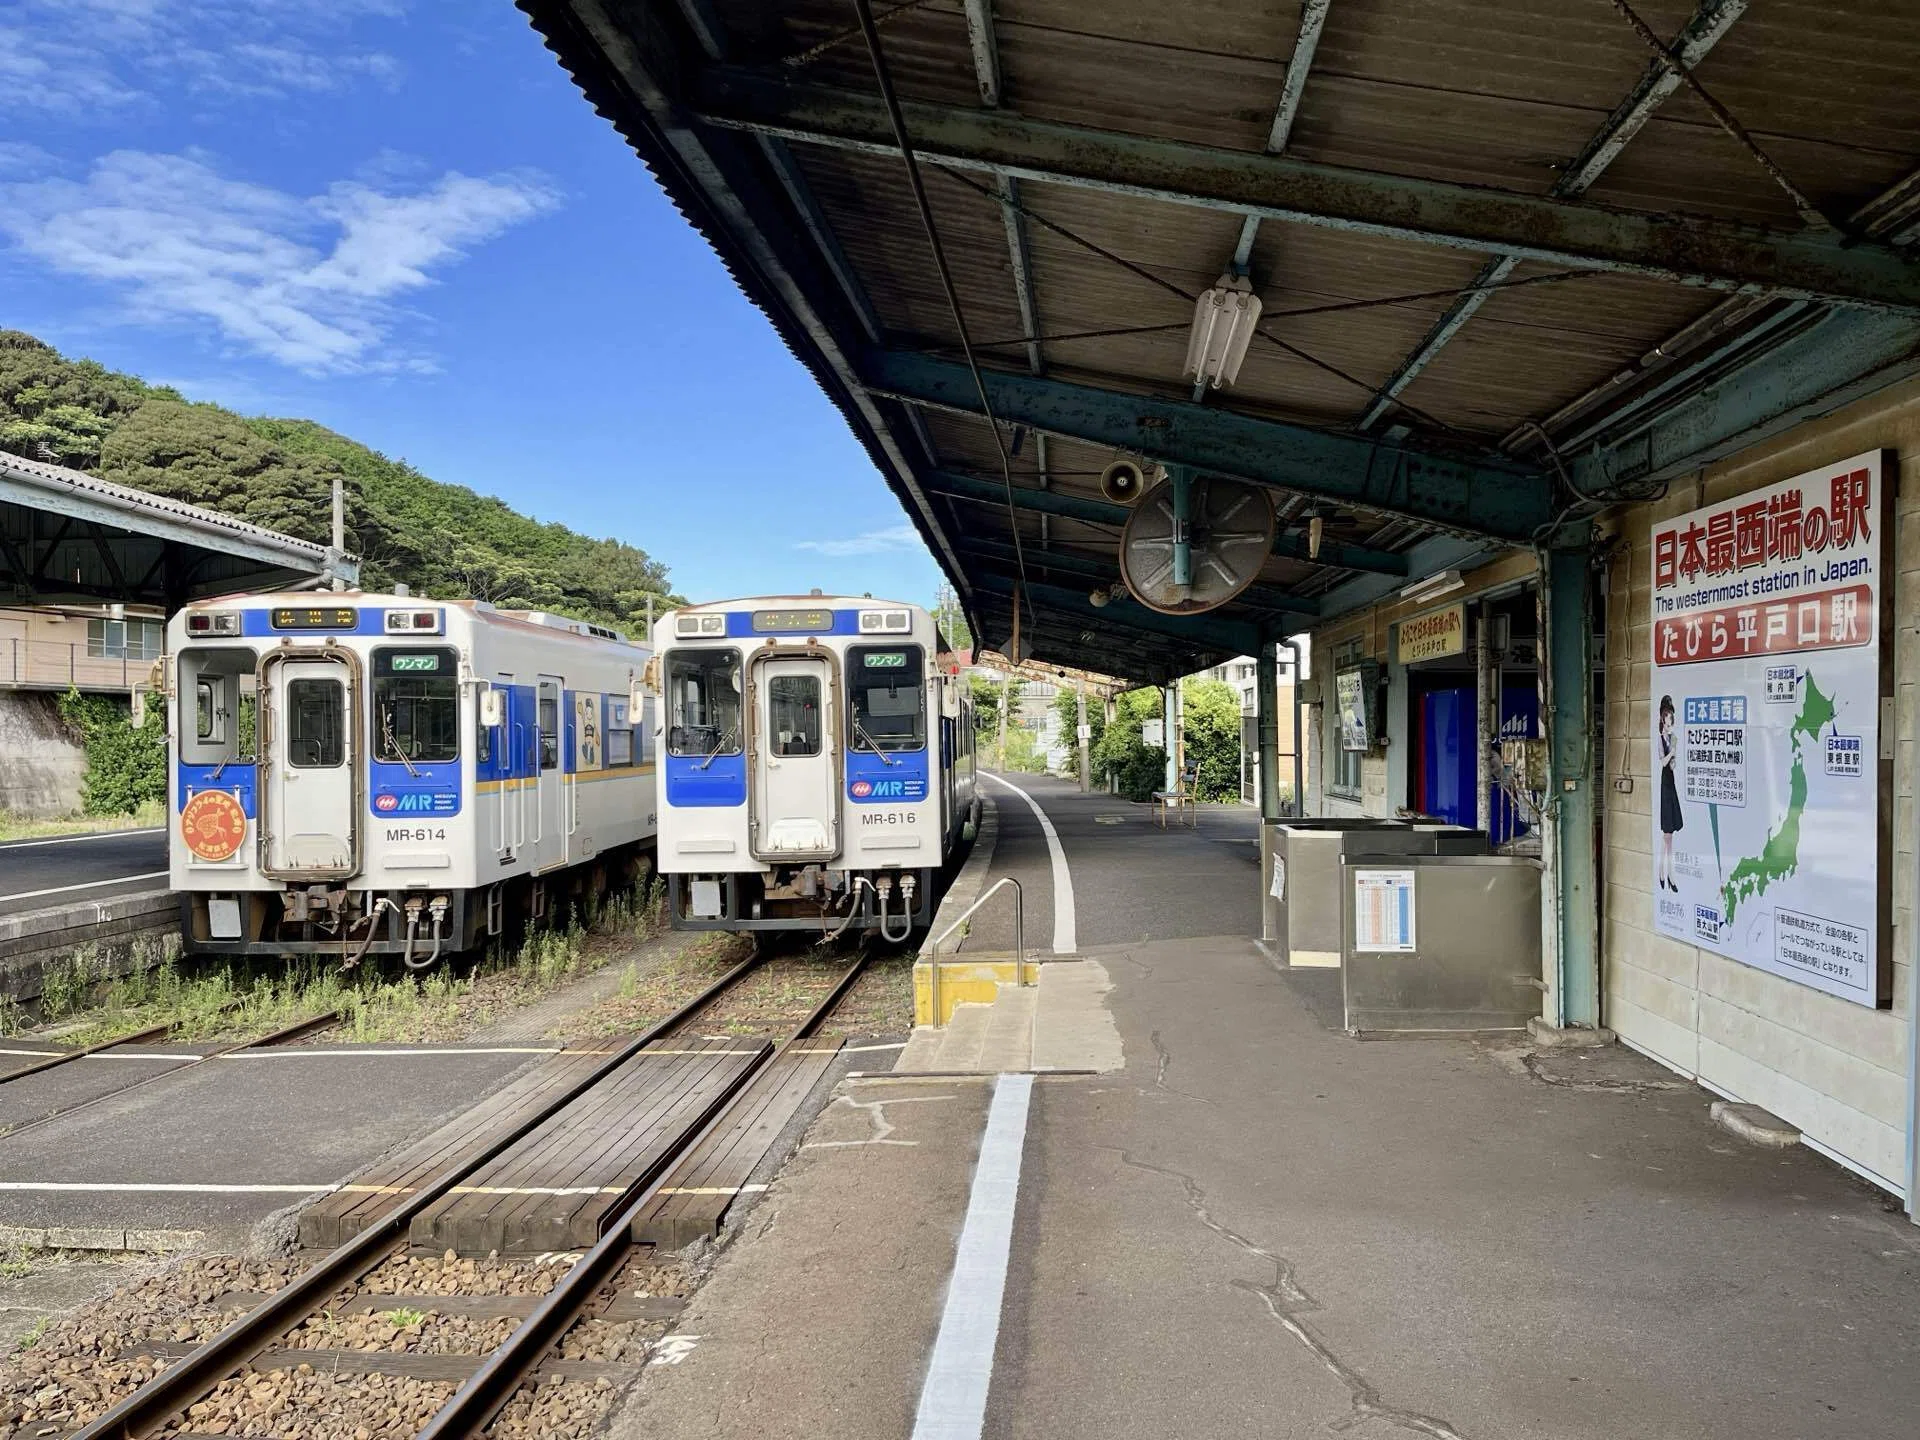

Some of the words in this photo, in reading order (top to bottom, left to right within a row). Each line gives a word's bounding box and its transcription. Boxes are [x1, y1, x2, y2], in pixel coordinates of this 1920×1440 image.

[1655, 468, 1871, 591] 日本最西端の駅
[1655, 596, 1674, 614] The
[1676, 580, 1750, 609] westernmost
[1752, 568, 1799, 595] station
[1803, 565, 1816, 585] in
[1820, 556, 1872, 583] Japan.
[1662, 591, 1858, 659] たびら平戸口駅
[395, 658, 434, 670] ワンマン
[868, 656, 902, 666] ワンマン
[1687, 699, 1744, 721] 日本最西端
[1687, 729, 1743, 747] たびら平戸口駅
[1827, 739, 1860, 752] 日本最東端
[872, 781, 903, 796] MR
[397, 794, 432, 811] MR
[862, 812, 916, 825] MR-616
[386, 828, 446, 841] MR-614
